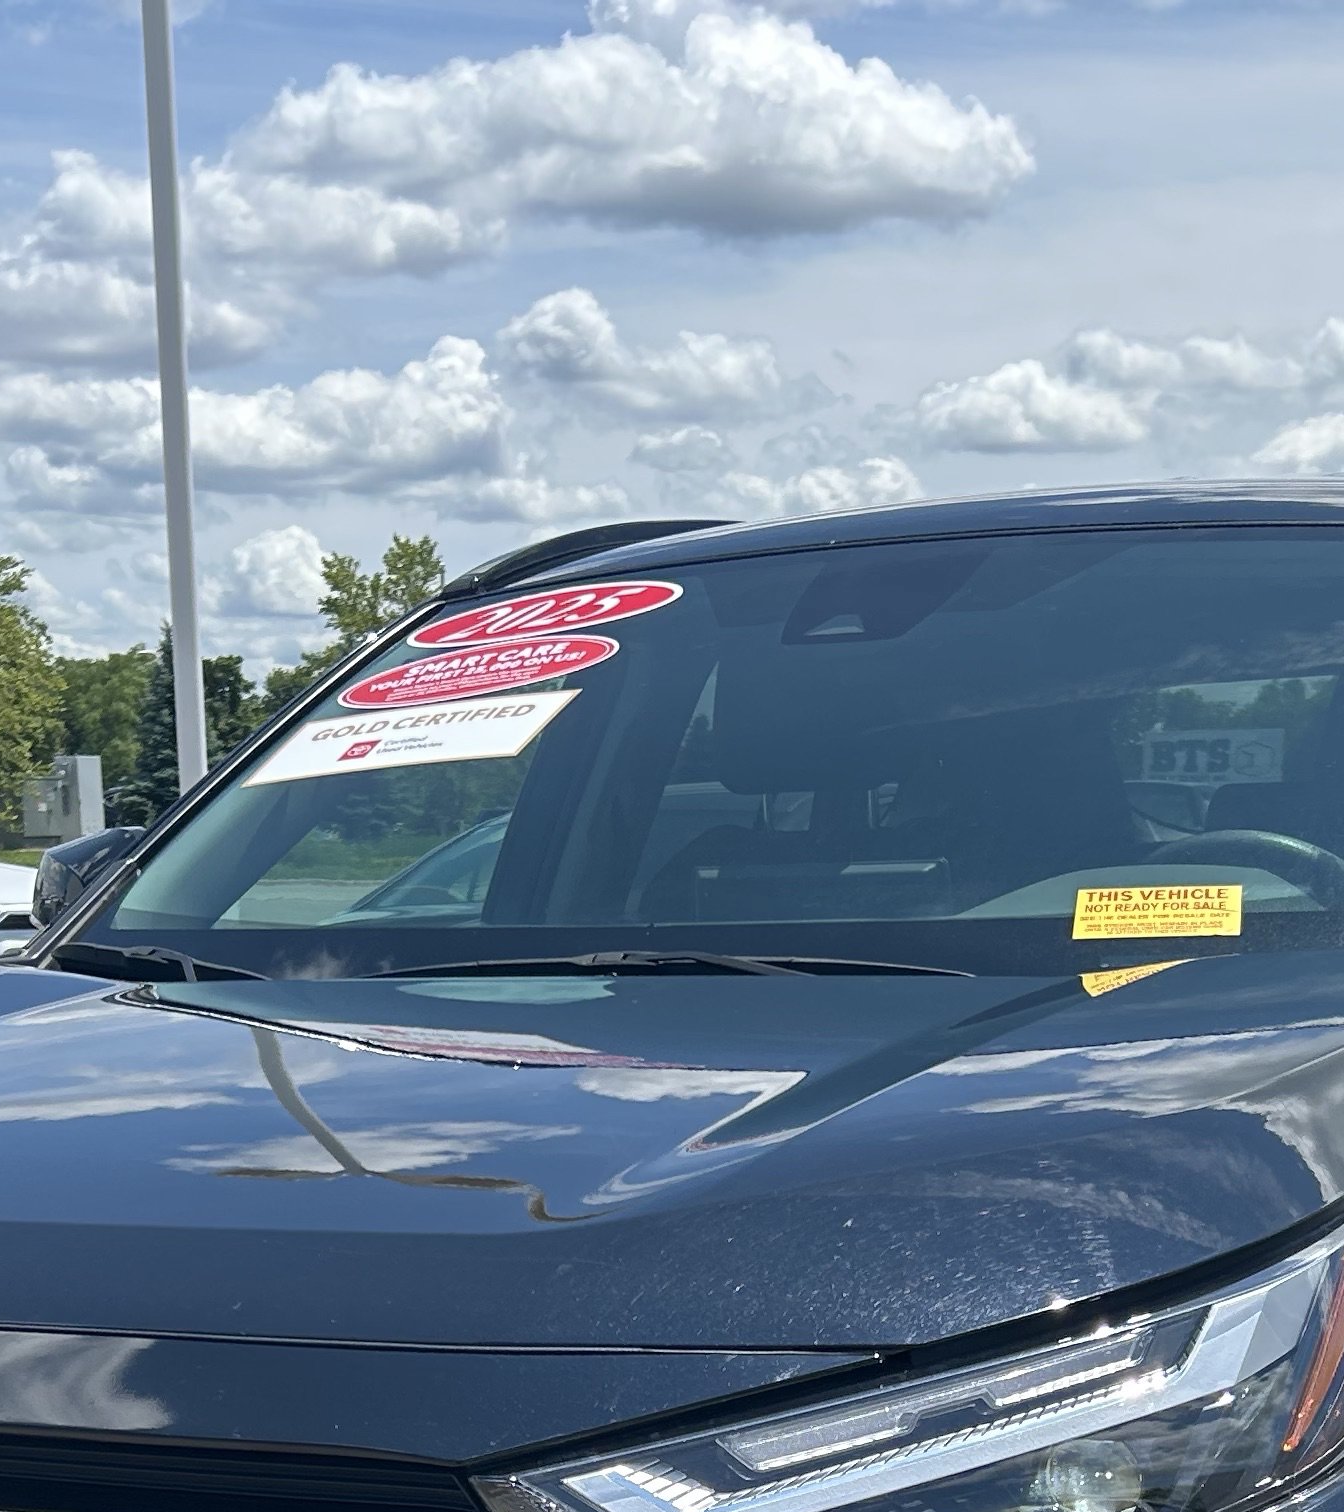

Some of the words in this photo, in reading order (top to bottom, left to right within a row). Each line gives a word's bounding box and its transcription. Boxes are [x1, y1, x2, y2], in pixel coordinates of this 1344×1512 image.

[436, 587, 648, 643] 2025
[370, 677, 416, 692] YOUR
[415, 668, 465, 684] FIRST
[522, 655, 553, 667] ON
[553, 650, 587, 663] US!
[404, 652, 498, 678] SMART
[497, 642, 572, 662] CARE
[311, 720, 390, 742] GOLD
[392, 704, 537, 730] CERTIFIED
[1084, 903, 1111, 913] NOT
[1114, 902, 1159, 912] READY
[1162, 901, 1190, 911] FOR
[1193, 901, 1227, 911] SALE
[1086, 889, 1133, 903] THIS
[1139, 887, 1230, 902] VEHICLE
